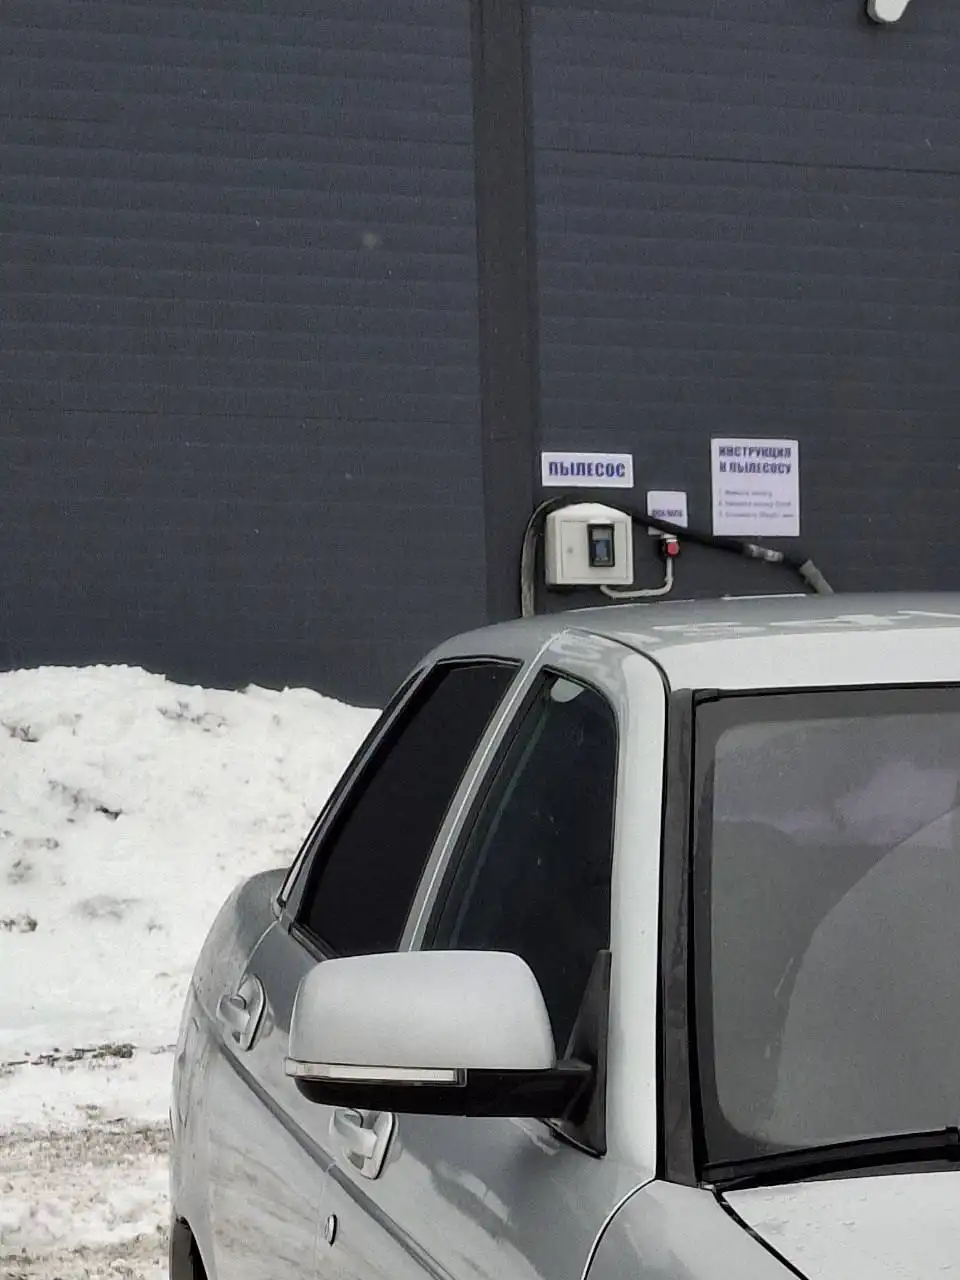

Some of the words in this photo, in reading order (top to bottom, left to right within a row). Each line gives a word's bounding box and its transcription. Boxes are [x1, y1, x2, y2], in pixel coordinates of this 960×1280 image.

[719, 446, 792, 460] ИНСТРУКЦИЯ
[548, 461, 626, 477] ПЫЛЕСОС
[729, 462, 792, 475] ПЫЛЕСОСУ
